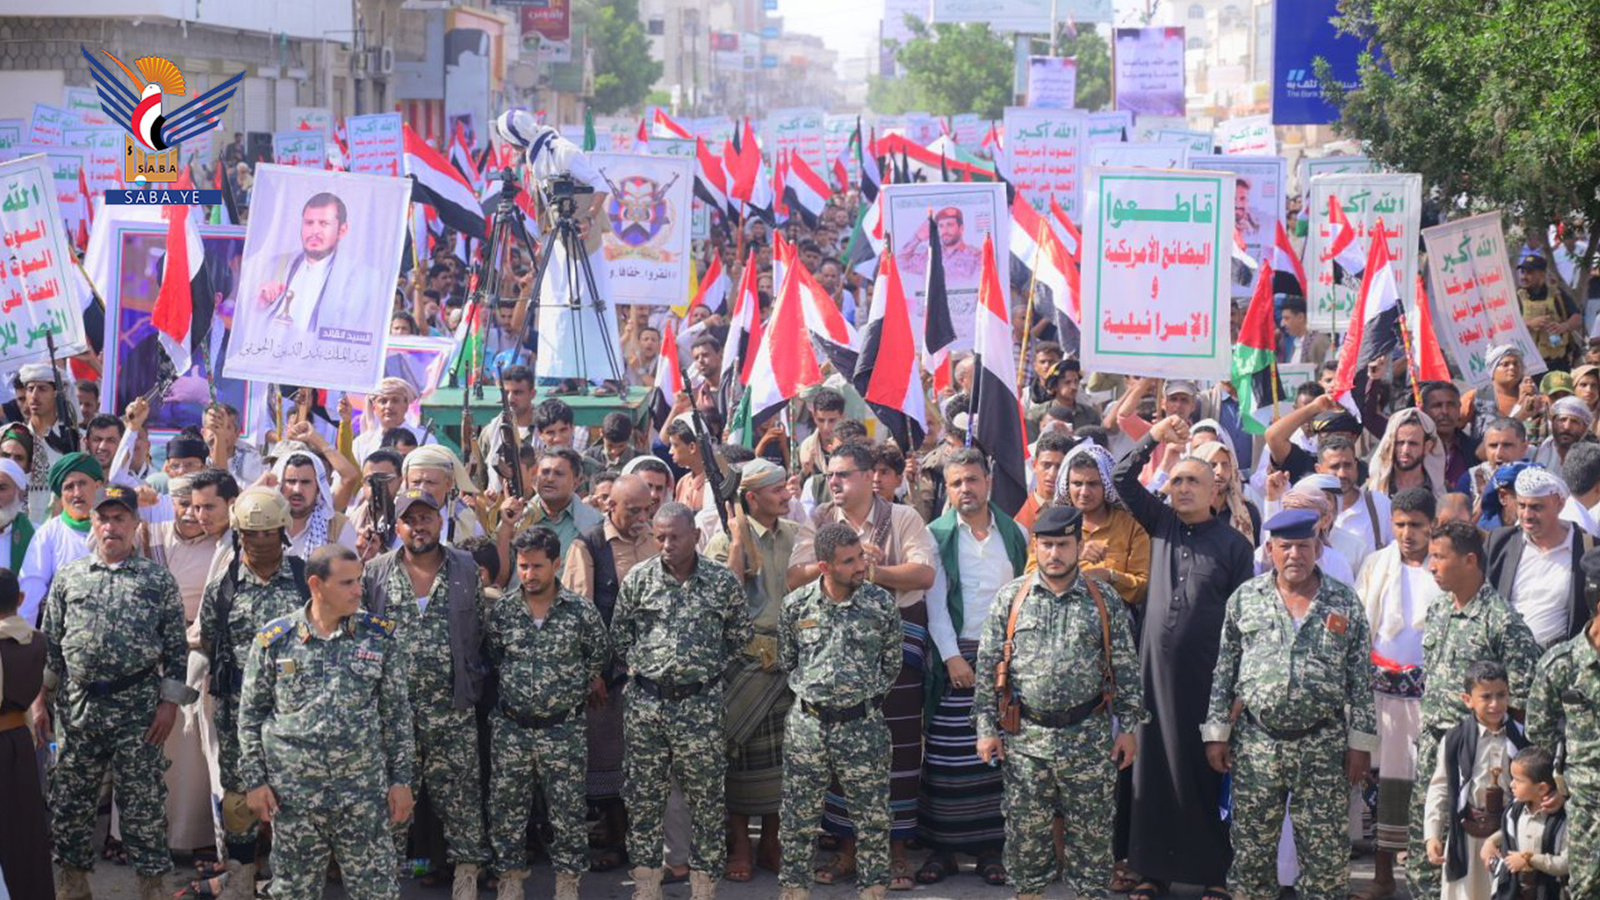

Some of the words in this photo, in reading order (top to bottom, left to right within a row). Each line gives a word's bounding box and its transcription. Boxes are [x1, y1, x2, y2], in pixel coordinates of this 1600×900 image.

[2, 181, 40, 213] الله
[1106, 191, 1212, 229] قاطعوا
[1373, 191, 1404, 213] الله
[4, 218, 47, 248] الموت
[1476, 233, 1497, 258] الله
[11, 248, 53, 278] الموت
[1105, 235, 1160, 270] الأمريكية
[1161, 240, 1211, 271] البضائع
[2, 288, 23, 315] على
[27, 277, 60, 303] اللعنة
[1151, 275, 1159, 300] و
[24, 308, 69, 349] النصر
[1103, 310, 1209, 342] الإسرائيلية
